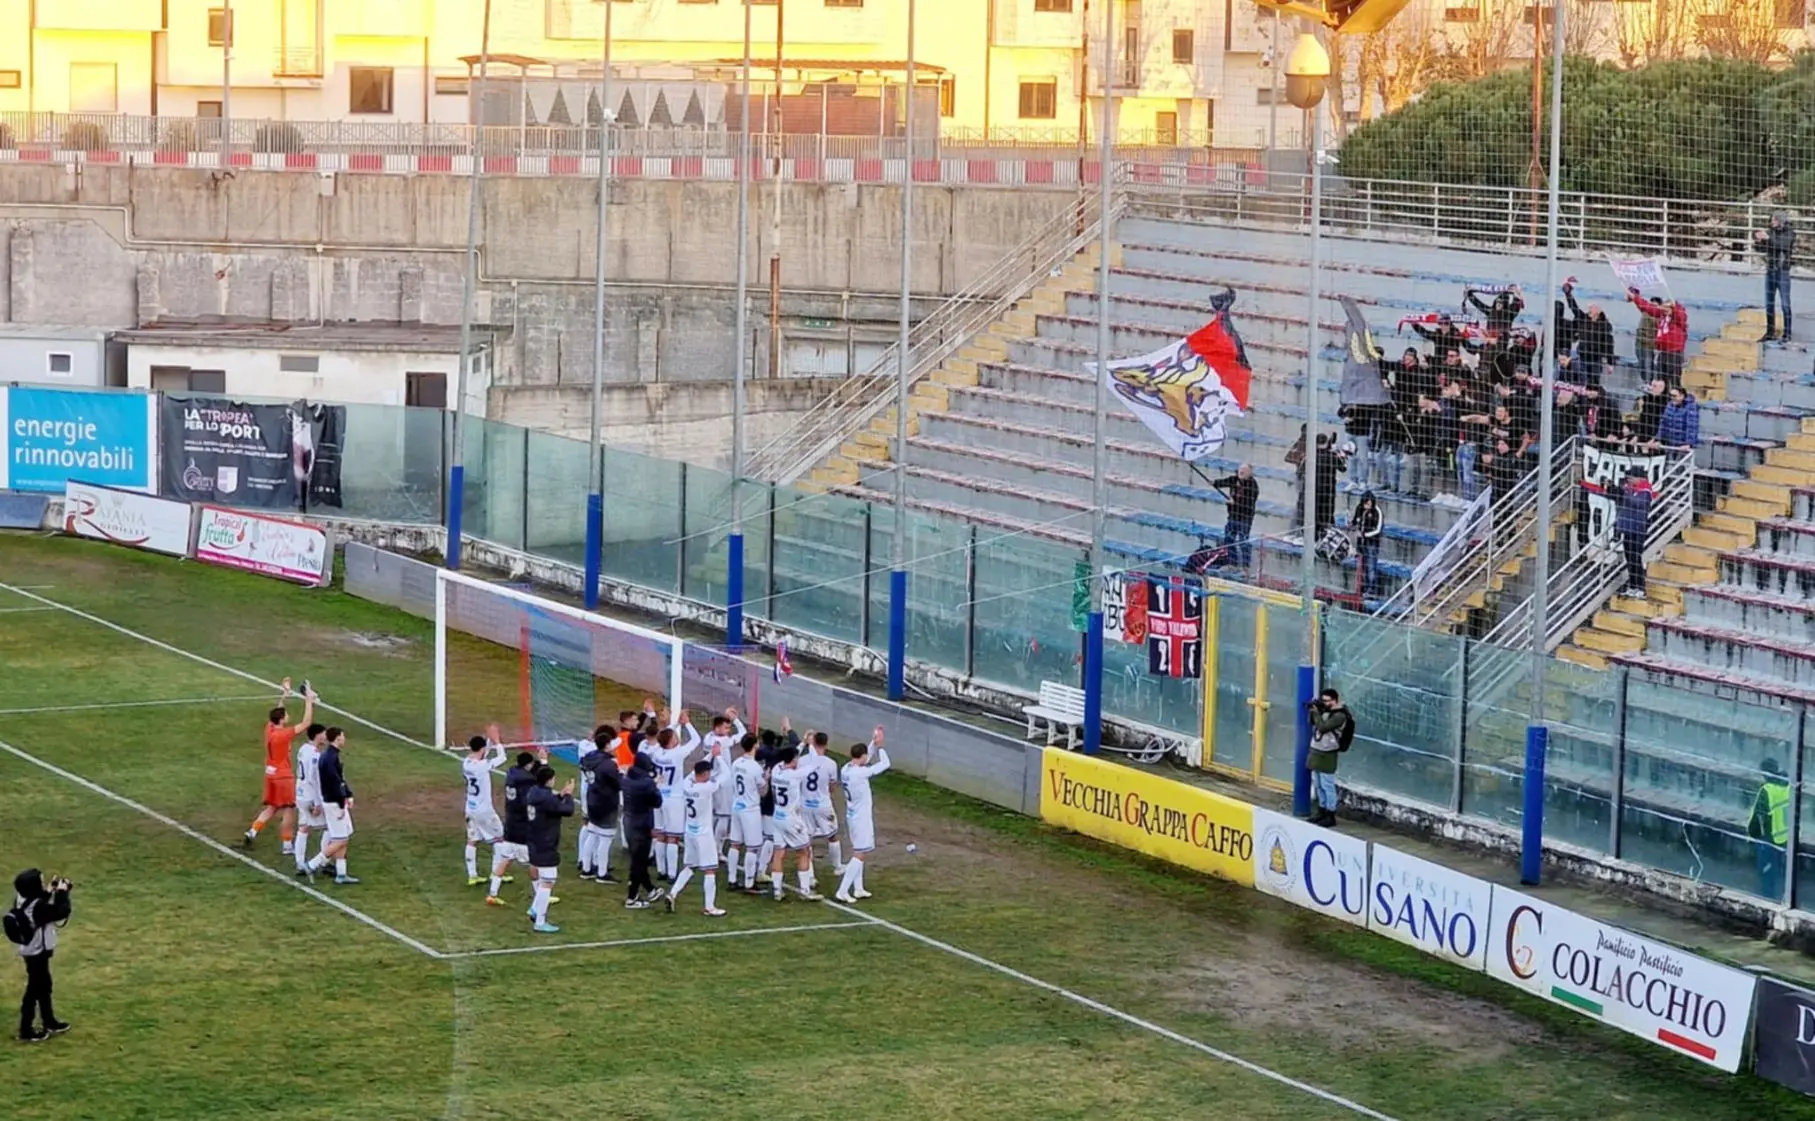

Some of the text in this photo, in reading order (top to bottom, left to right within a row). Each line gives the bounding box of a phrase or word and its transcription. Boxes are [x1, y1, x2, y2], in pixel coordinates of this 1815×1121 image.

[184, 408, 200, 421] LA
[206, 421, 219, 431] LO
[14, 416, 98, 446] energie
[15, 440, 134, 470] rinnovabili
[203, 522, 235, 546] frutta
[735, 774, 746, 796] 6
[806, 770, 819, 792] 8
[1050, 768, 1122, 823] VECCHIA
[1124, 792, 1189, 843] GRAPPA
[1191, 812, 1253, 862] CAFFO
[1303, 839, 1477, 959] CUSANO
[1597, 929, 1685, 979] Panificio Pastificio
[1552, 942, 1726, 1039] COLACCHIO
